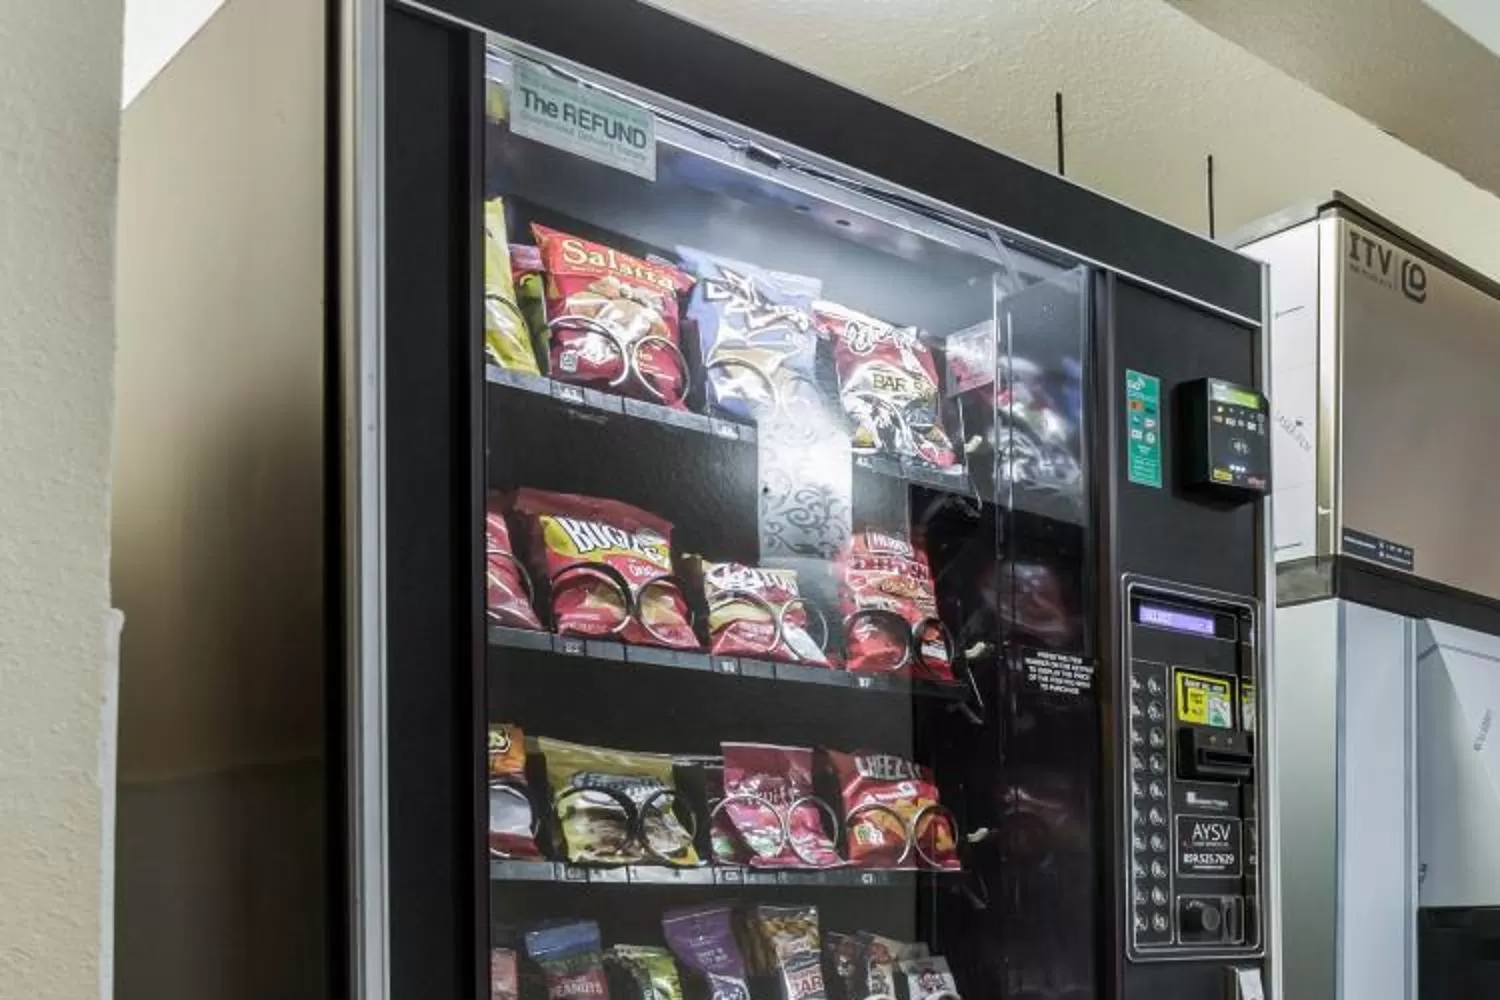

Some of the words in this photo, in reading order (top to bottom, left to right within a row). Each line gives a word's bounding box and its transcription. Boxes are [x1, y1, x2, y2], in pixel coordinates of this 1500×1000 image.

[520, 86, 559, 118] The
[563, 103, 648, 149] REFUND
[1349, 229, 1392, 276] ITV
[1193, 822, 1231, 842] AYSV
